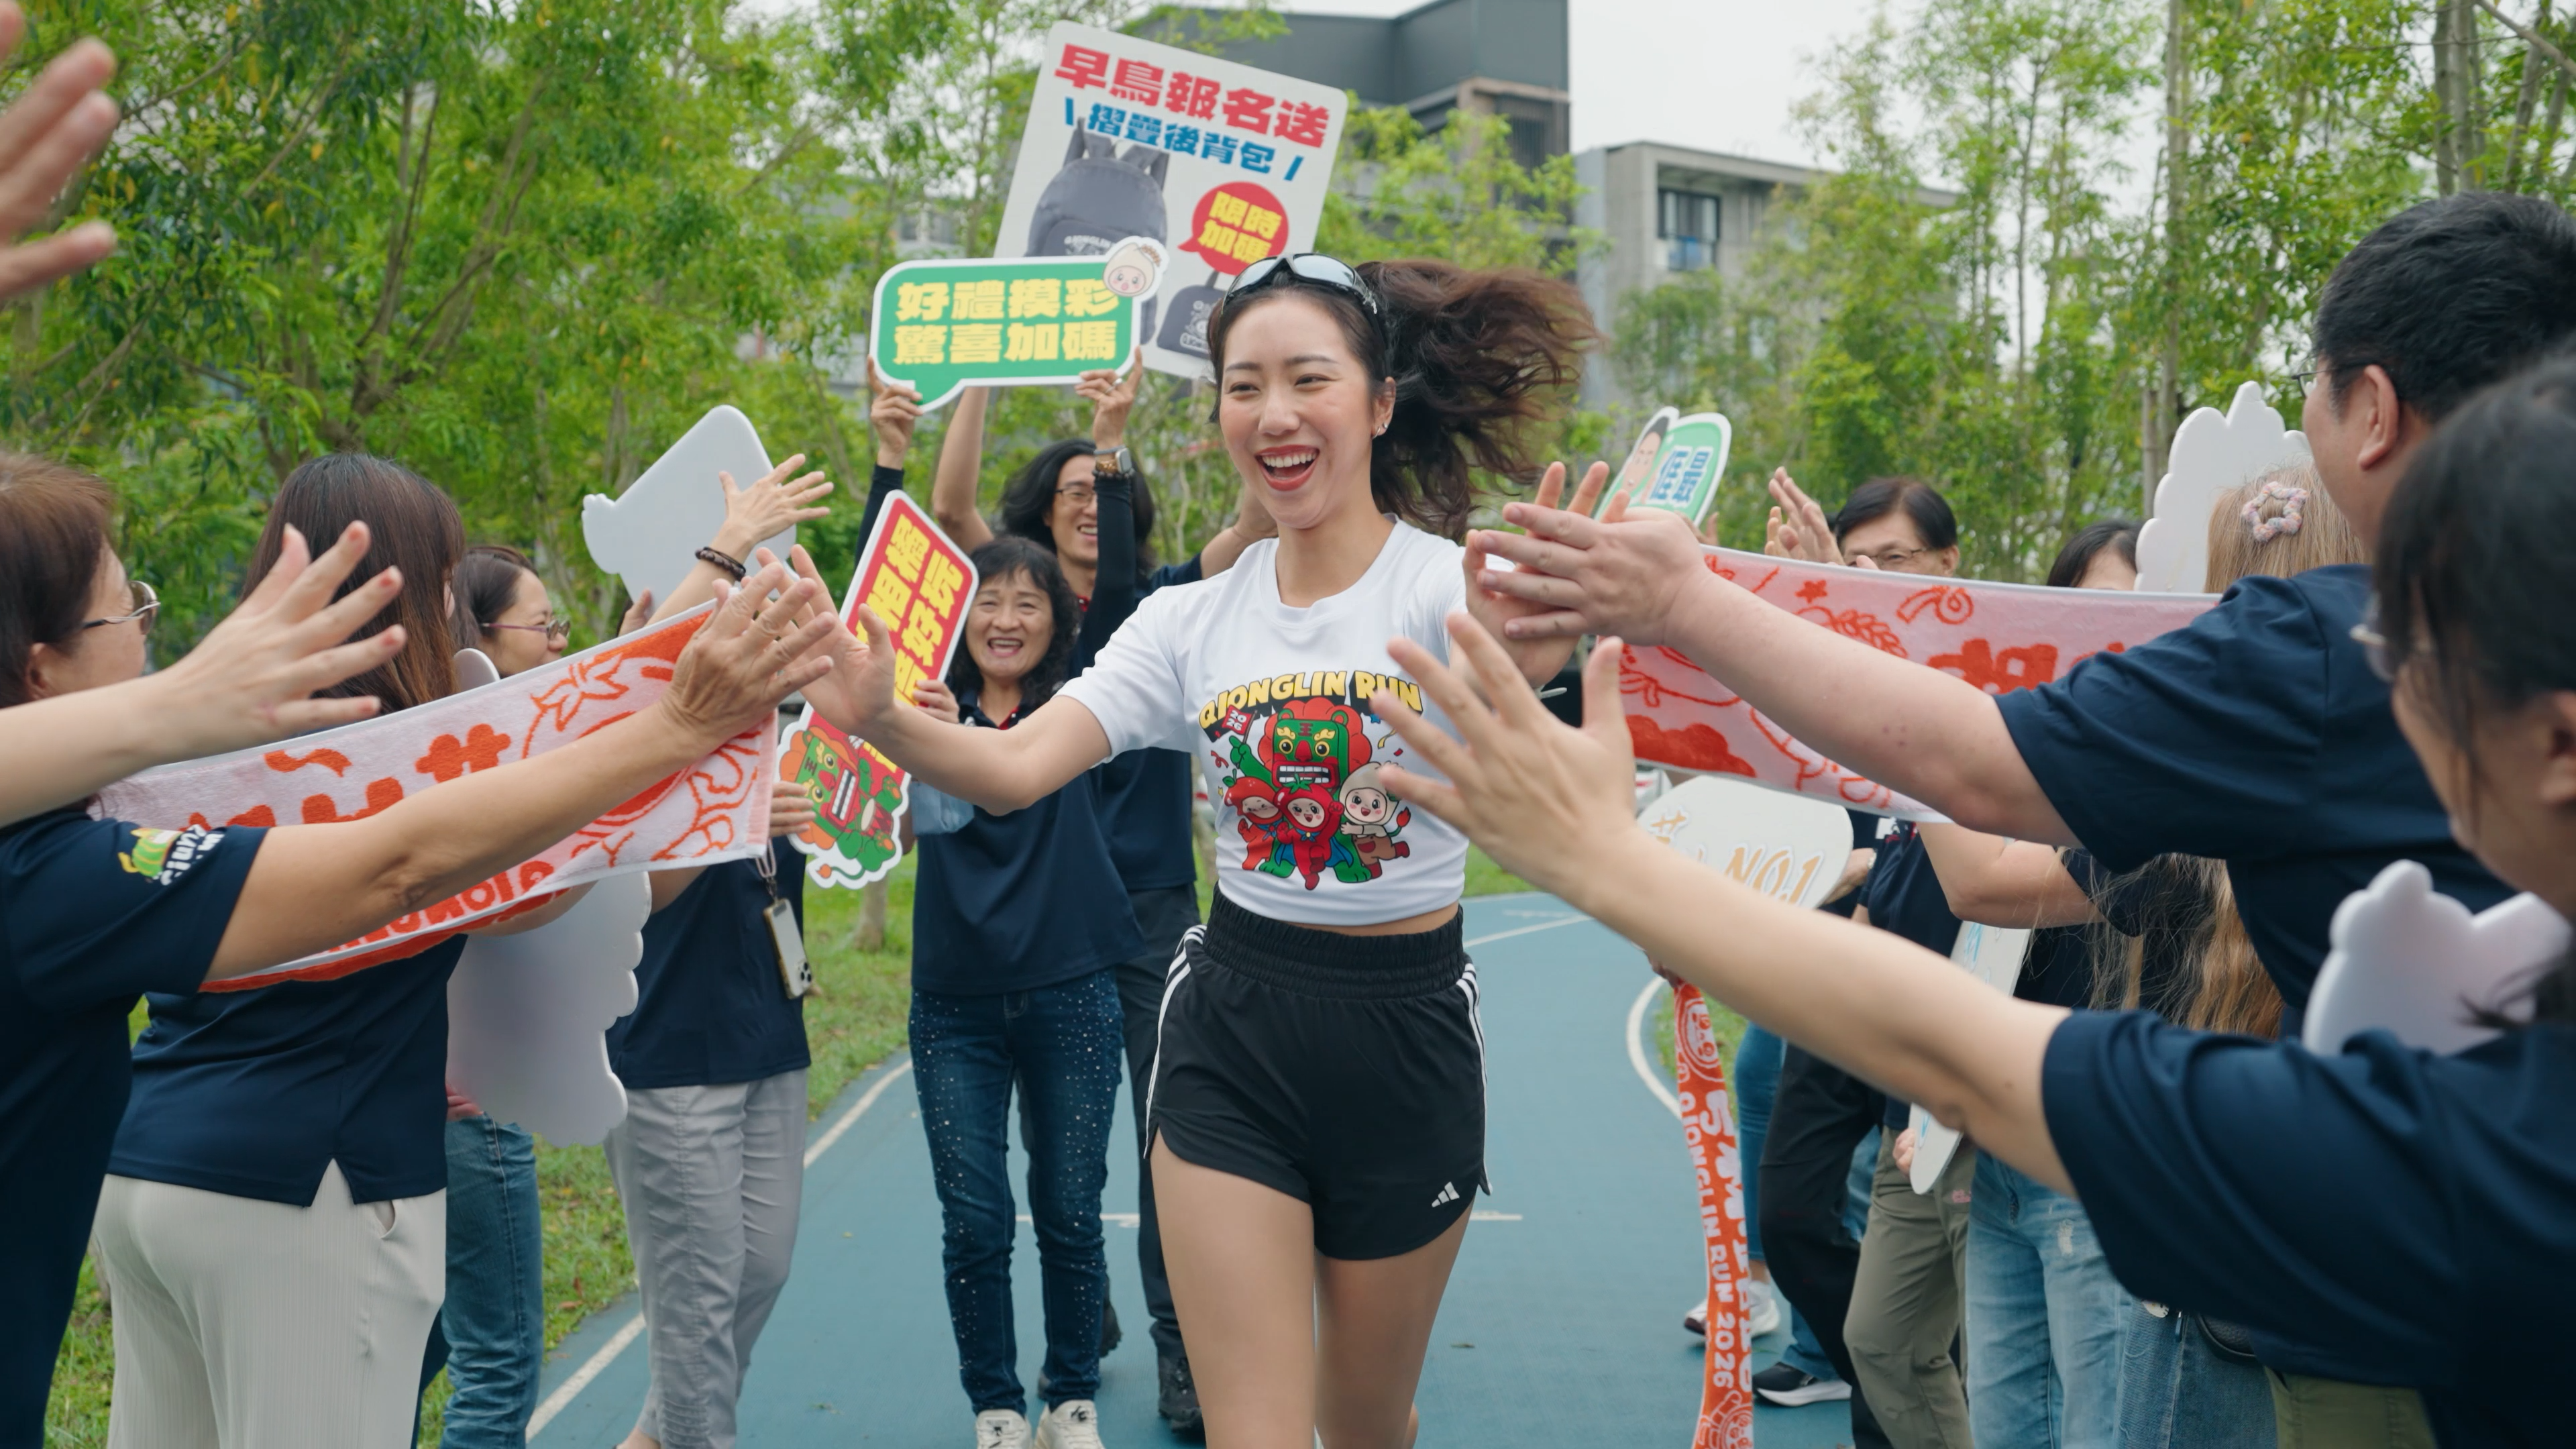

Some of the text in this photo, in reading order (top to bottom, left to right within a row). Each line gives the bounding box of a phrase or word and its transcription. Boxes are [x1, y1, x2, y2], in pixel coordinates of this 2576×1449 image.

[1054, 43, 1330, 148] 早鳥報名送
[1087, 102, 1276, 174] 摺疊後背包
[1197, 218, 1272, 264] 加碼
[1208, 191, 1283, 239] 限時
[895, 278, 1120, 322] 好禮摸彩
[893, 320, 1118, 365] 驚喜加碼
[1199, 671, 1347, 730] QIONGLIN
[1710, 1244, 1734, 1303] RUN
[1713, 1311, 1736, 1389] 2026
